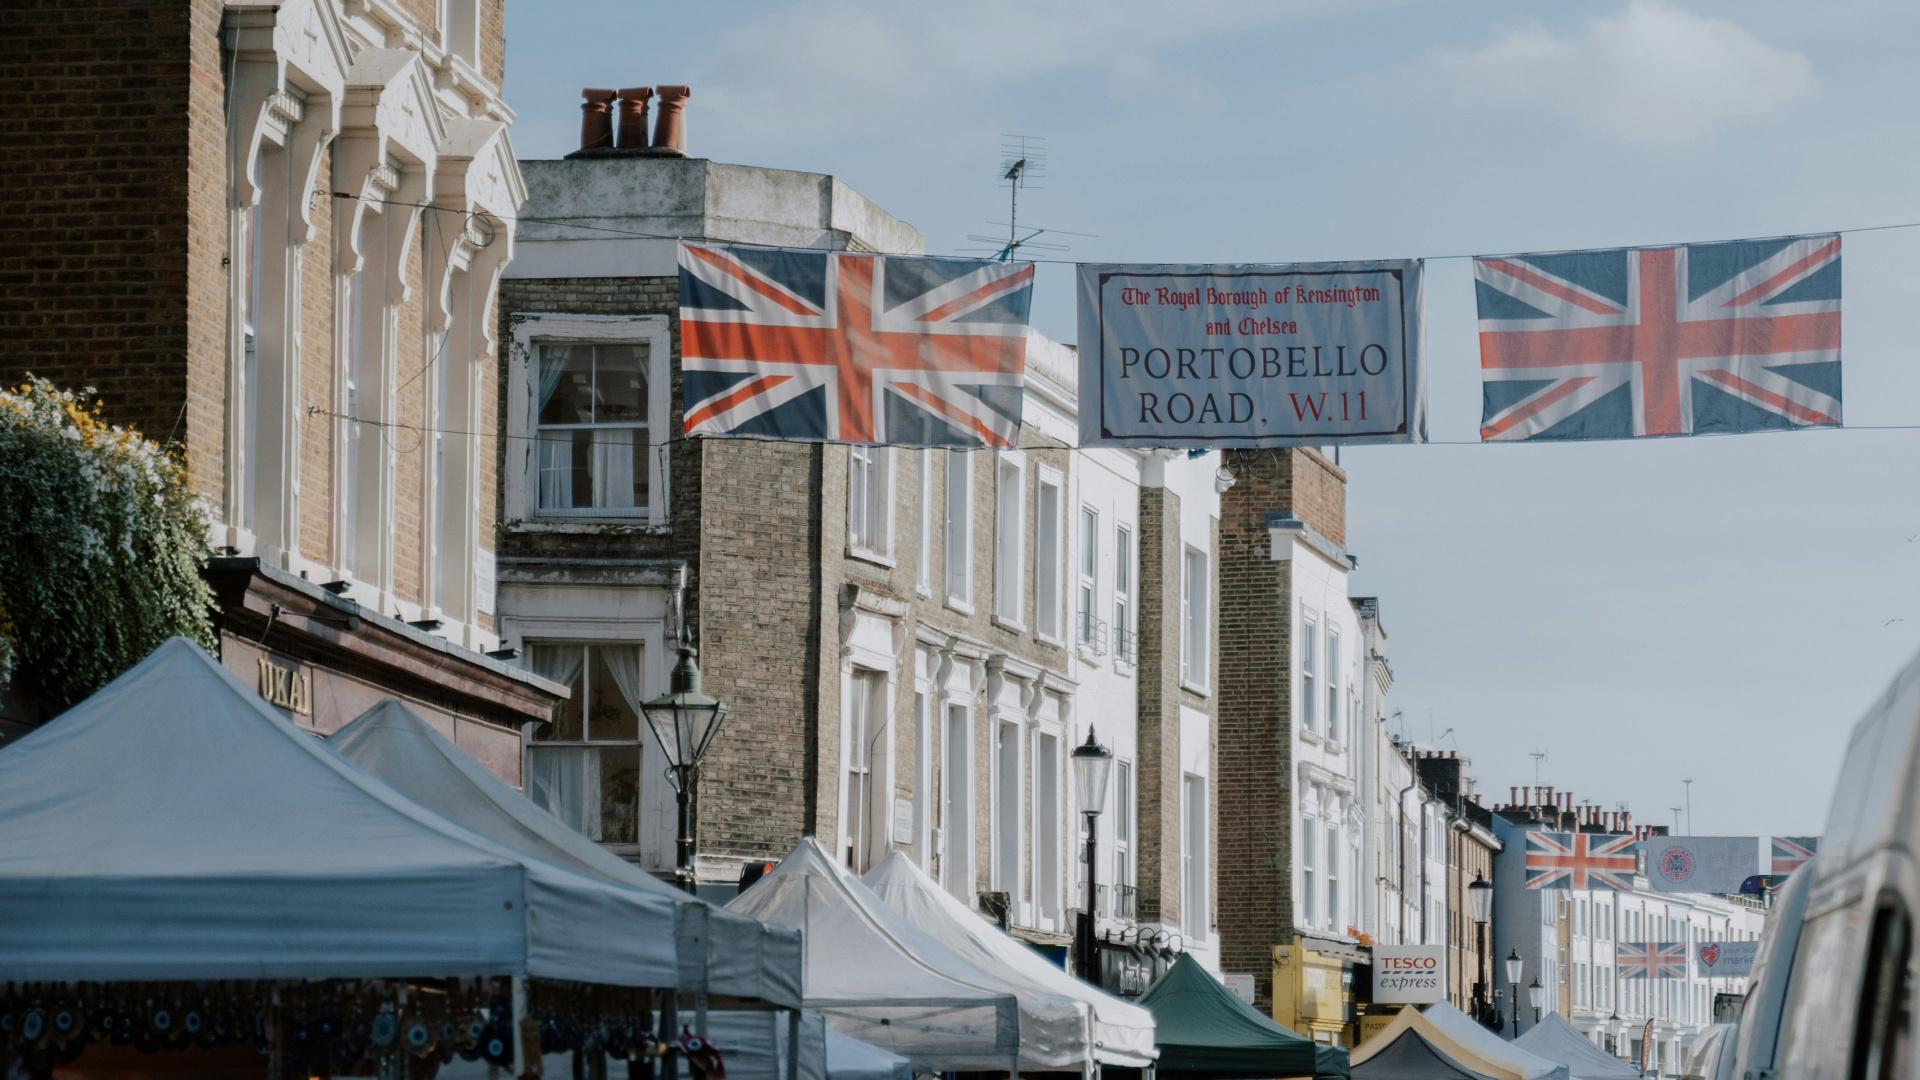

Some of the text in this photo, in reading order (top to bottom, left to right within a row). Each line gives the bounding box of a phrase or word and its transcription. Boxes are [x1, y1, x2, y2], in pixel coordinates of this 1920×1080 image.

[1121, 284, 1380, 312] The Royal Borough of Kensington
[1206, 317, 1298, 336] and Chelsea
[1119, 343, 1388, 380] PORTOBELLO
[1138, 390, 1368, 428] ROAD, W.11
[257, 658, 312, 716] UKAI
[1723, 946, 1757, 956] your loca
[1723, 956, 1755, 965] marke
[1380, 957, 1437, 969] TESCO
[1380, 976, 1437, 992] express
